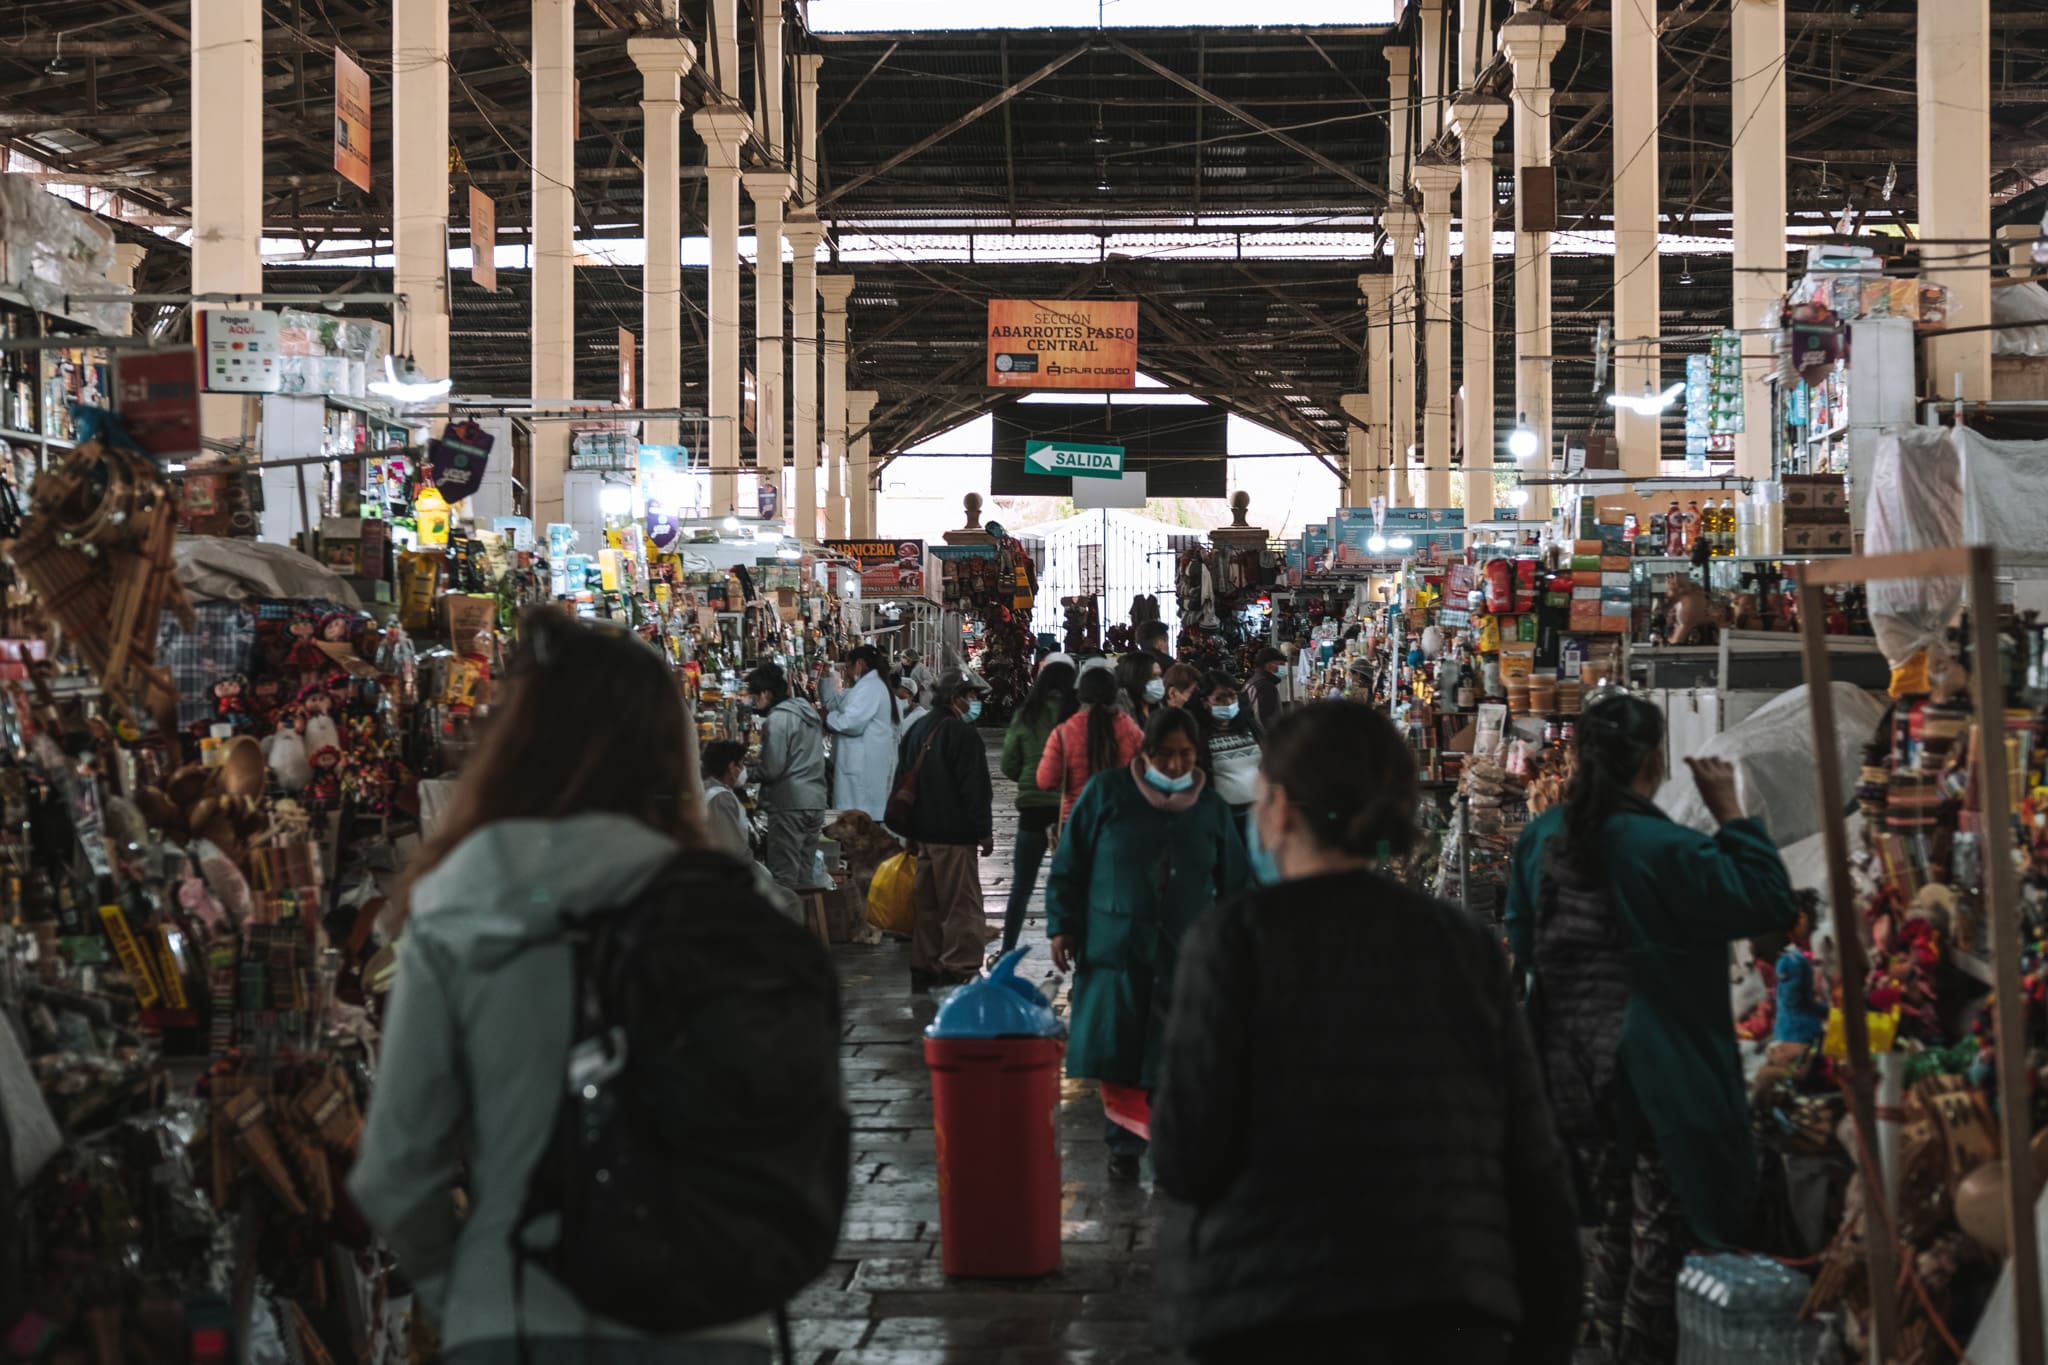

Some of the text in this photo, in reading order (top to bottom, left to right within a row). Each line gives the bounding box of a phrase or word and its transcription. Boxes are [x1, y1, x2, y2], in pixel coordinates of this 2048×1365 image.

[220, 316, 249, 325] Pague
[1034, 312, 1091, 325] SECCIÓN
[991, 326, 1134, 339] ABARROTES PASEO
[1027, 340, 1098, 352] CENTRAL
[1063, 367, 1130, 375] CAJA CUSCO
[1055, 452, 1113, 468] SALIDA
